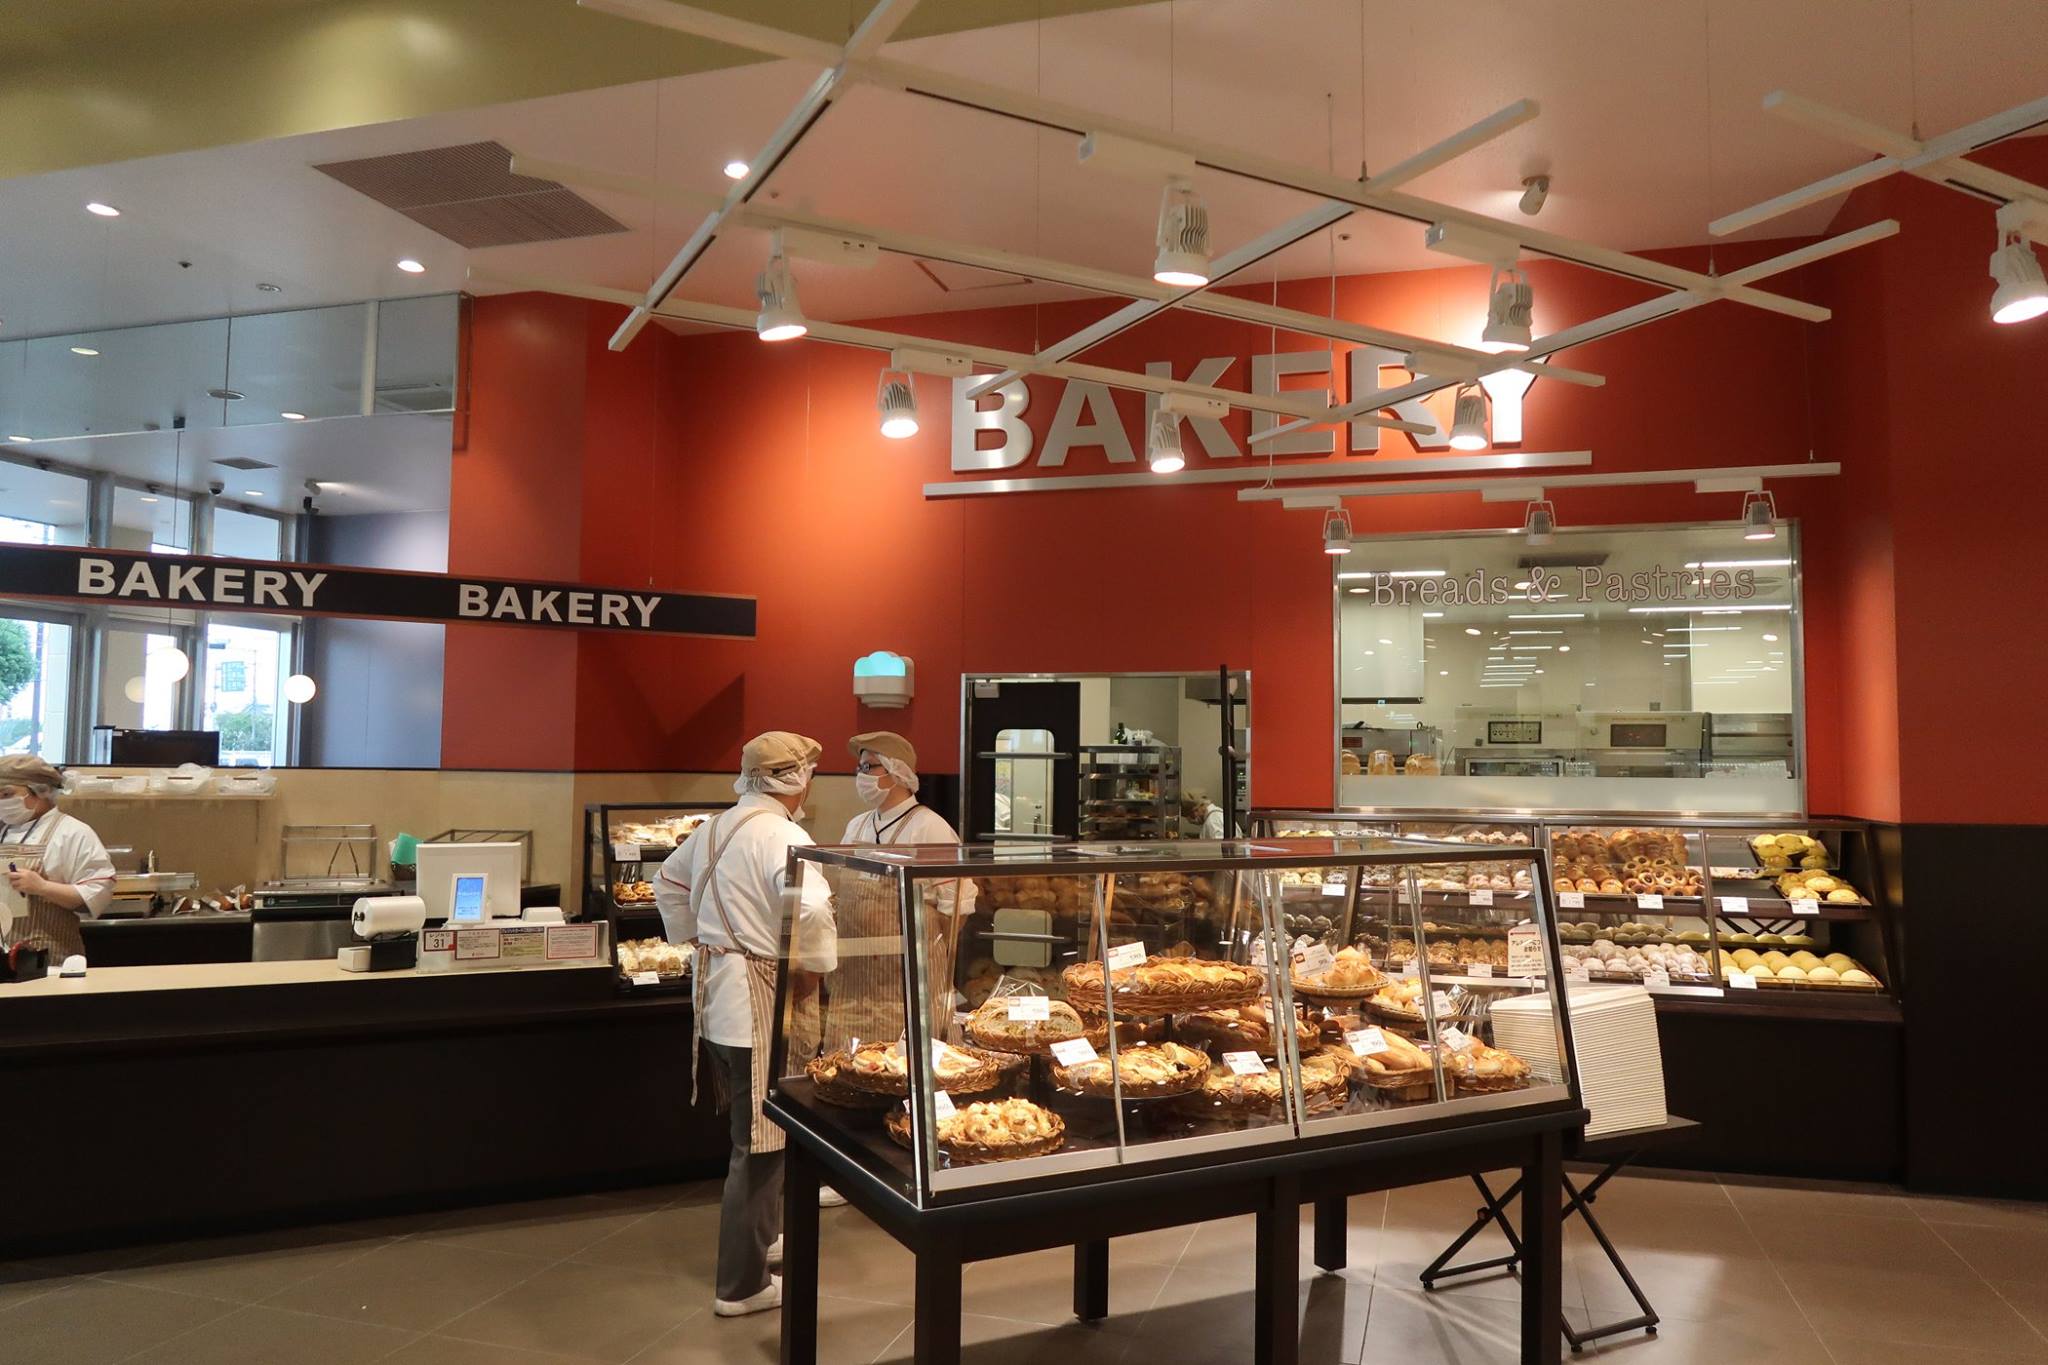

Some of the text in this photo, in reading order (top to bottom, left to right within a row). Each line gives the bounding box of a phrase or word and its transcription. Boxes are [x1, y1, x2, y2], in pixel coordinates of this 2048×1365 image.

[952, 347, 1551, 472] BAKERY
[78, 558, 328, 608] BAKERY
[459, 584, 662, 627] BAKERY
[1370, 561, 1756, 607] Breads & Pastries
[433, 938, 445, 948] 31
